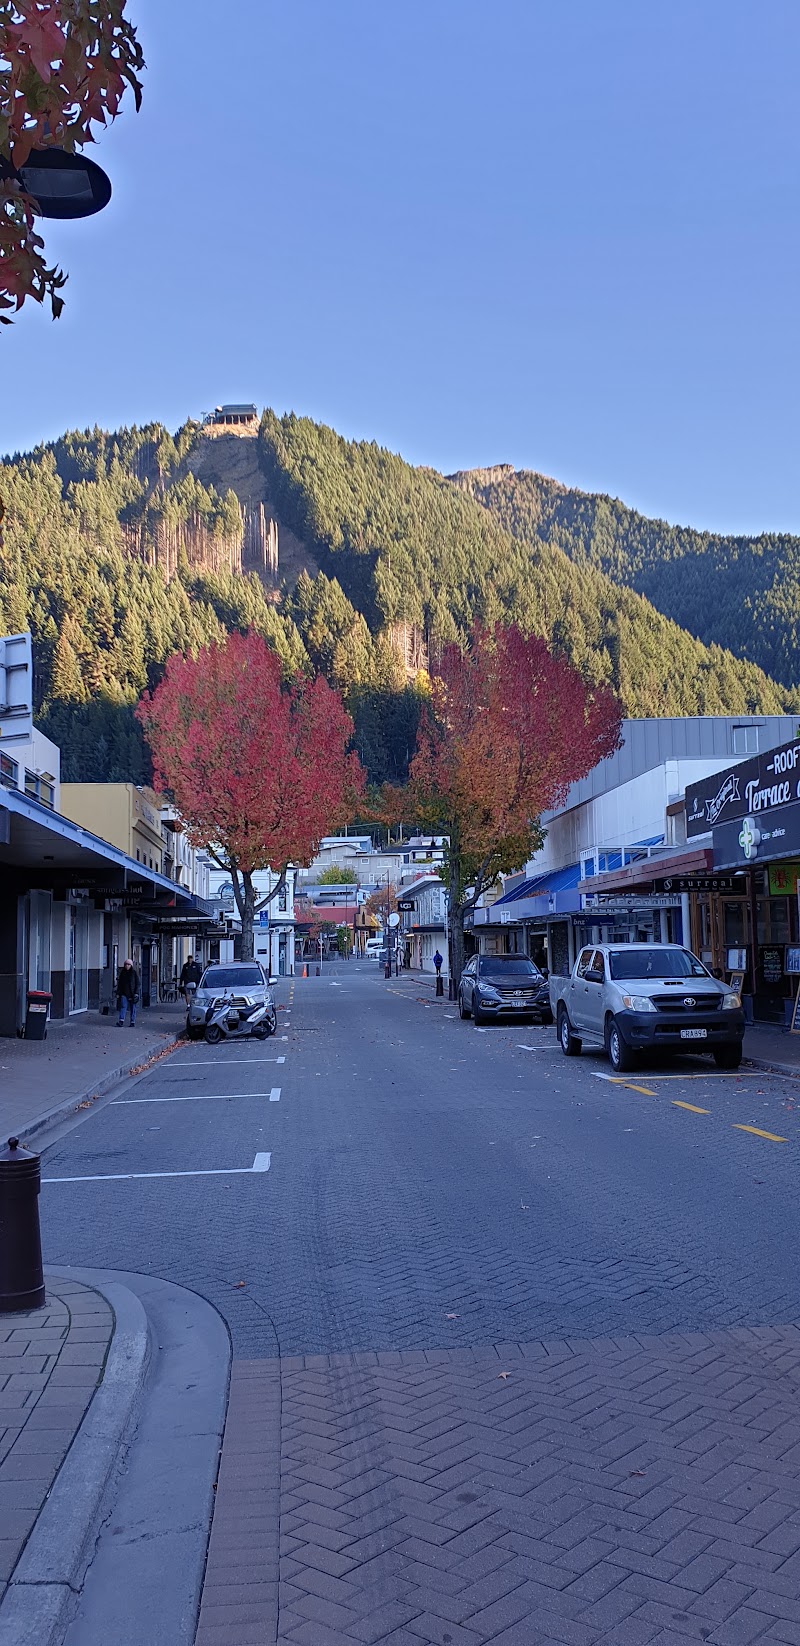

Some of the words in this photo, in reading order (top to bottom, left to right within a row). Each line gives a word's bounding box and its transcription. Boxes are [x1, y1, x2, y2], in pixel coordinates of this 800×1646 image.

[745, 779, 791, 812] Terrace
[687, 808, 705, 821] surreal
[679, 878, 733, 887] surreal
